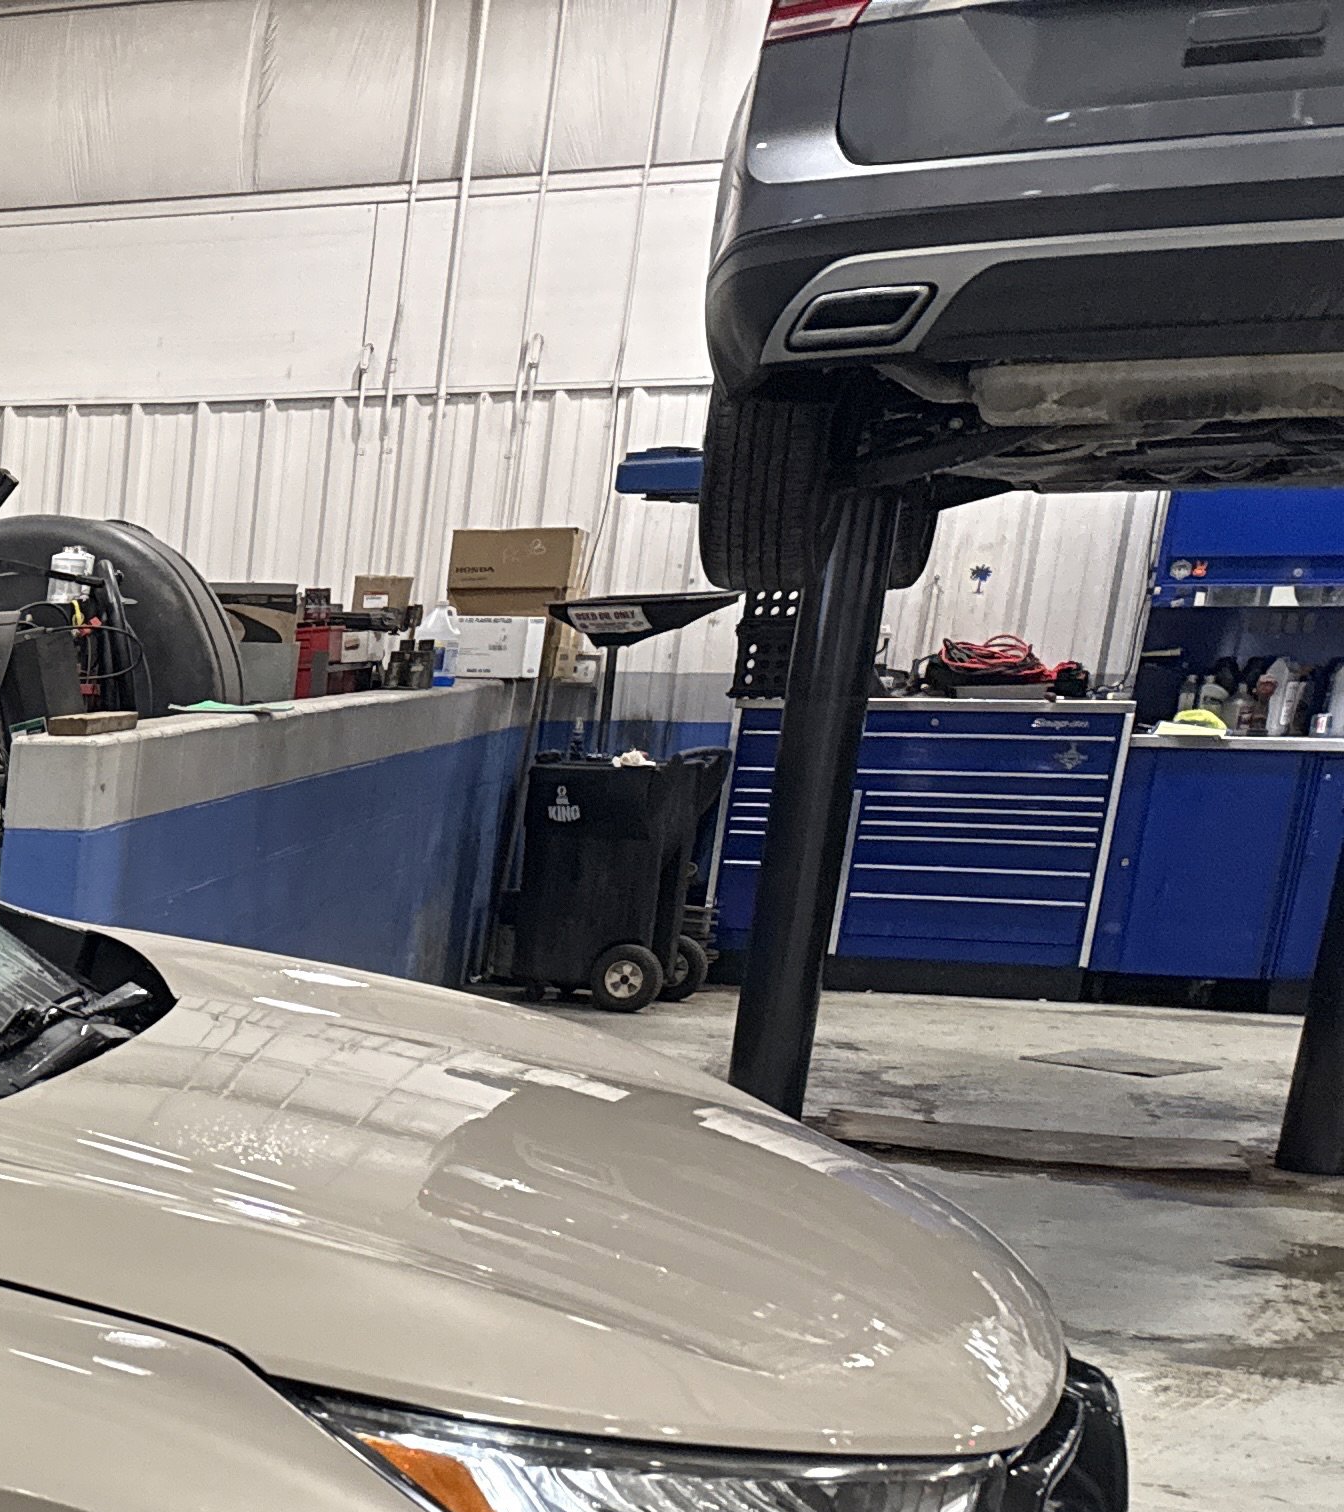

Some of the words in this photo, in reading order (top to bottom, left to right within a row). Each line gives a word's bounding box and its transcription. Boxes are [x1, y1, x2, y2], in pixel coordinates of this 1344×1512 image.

[455, 566, 495, 574] HONDA
[613, 609, 635, 620] ONLY
[547, 804, 581, 823] KING
